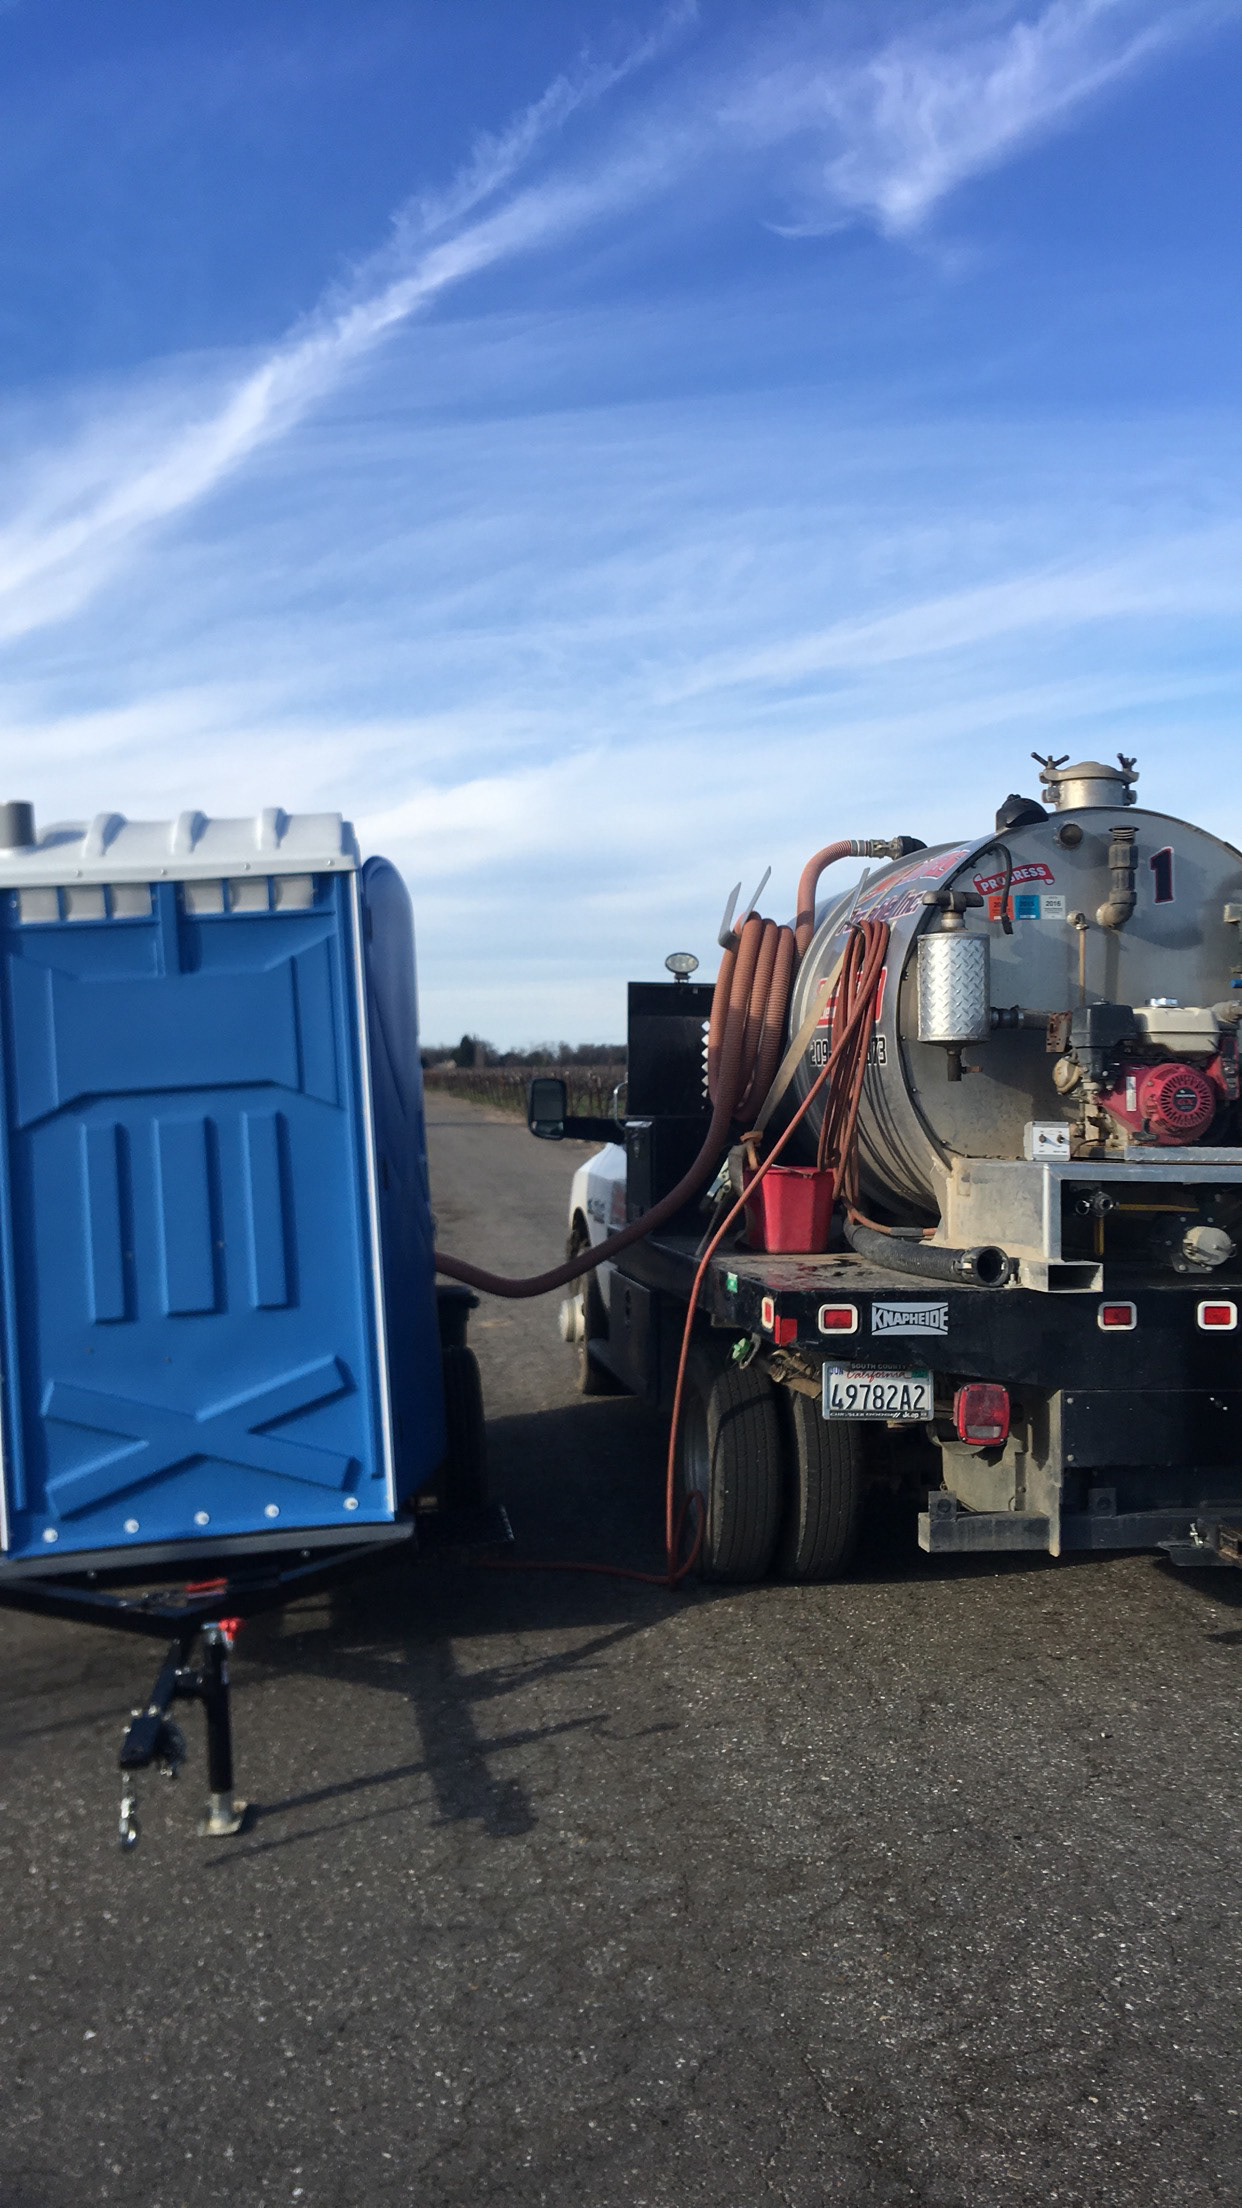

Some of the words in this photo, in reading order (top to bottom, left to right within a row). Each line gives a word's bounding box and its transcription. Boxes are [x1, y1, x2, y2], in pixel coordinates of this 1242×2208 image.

[980, 866, 1047, 892] PRORESS
[1149, 846, 1174, 905] 1
[872, 1305, 949, 1332] KNAPHEIDE
[846, 1370, 906, 1382] California
[851, 1362, 876, 1370] SOUTH
[831, 1383, 926, 1410] 49782A2
